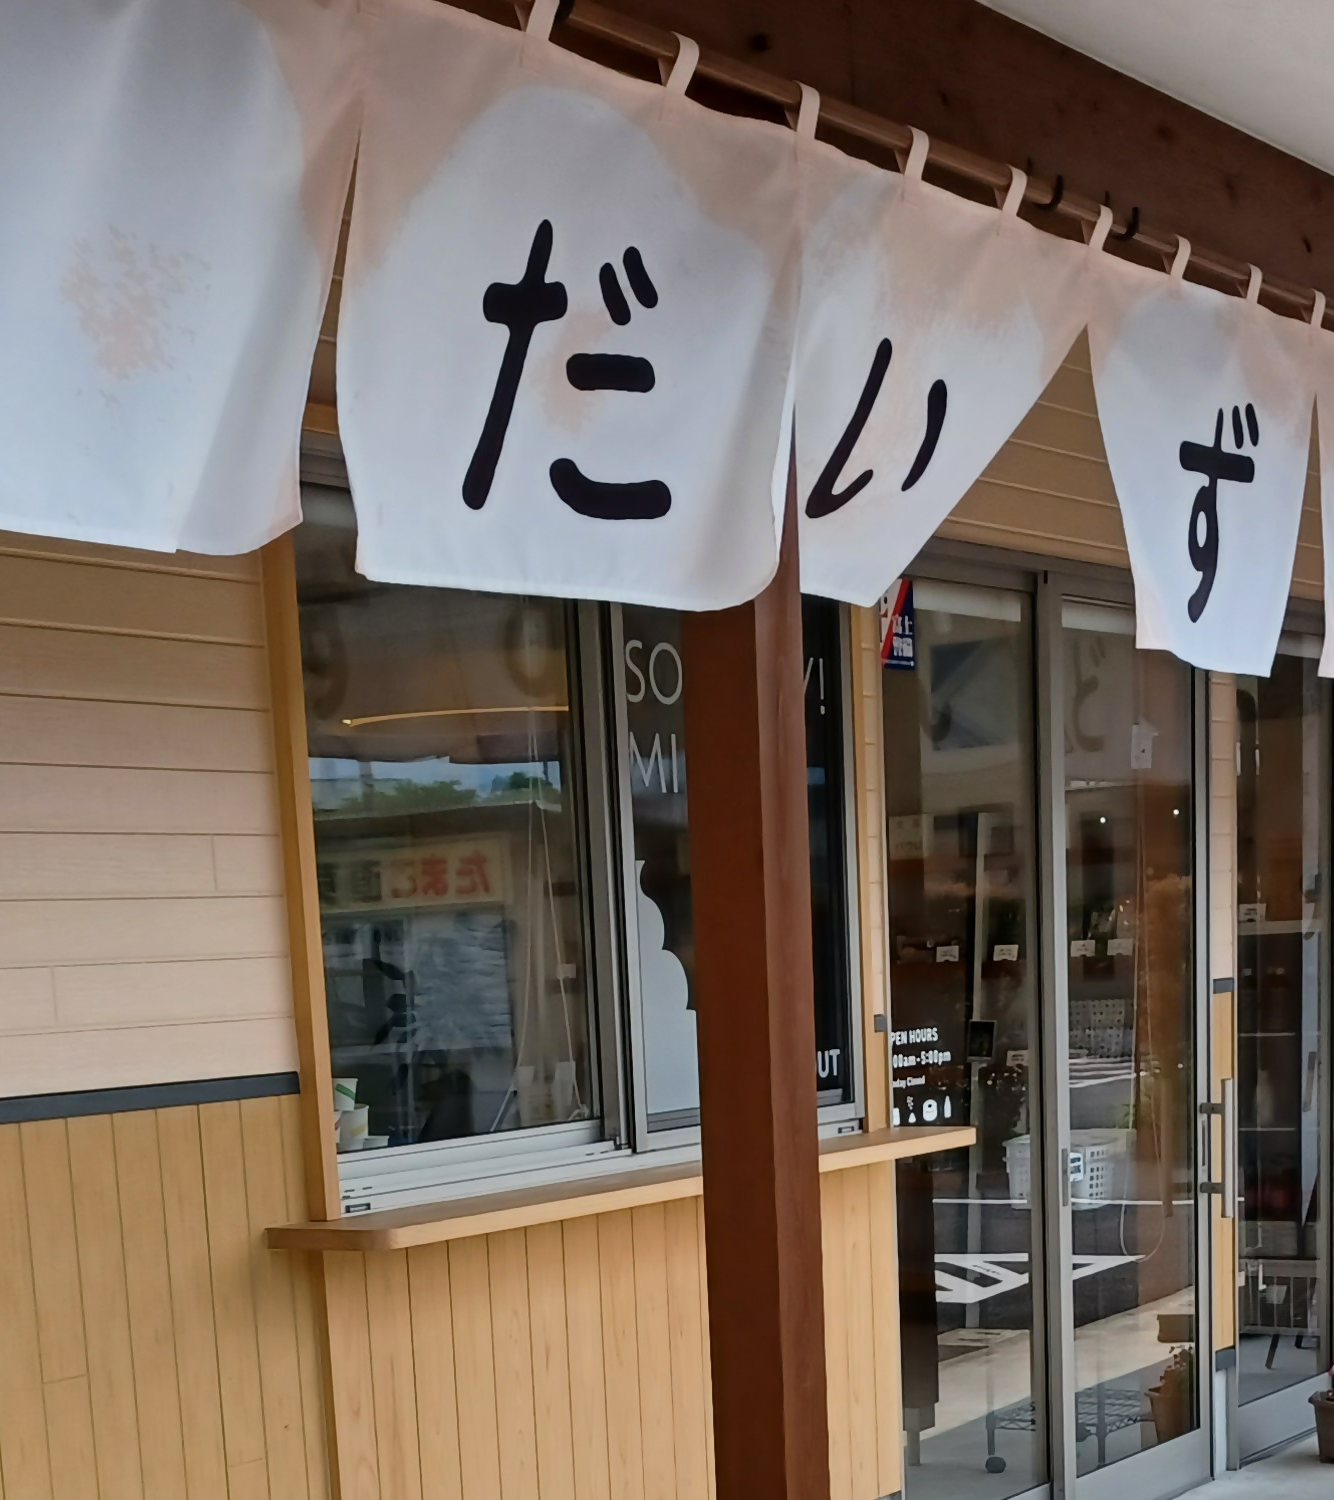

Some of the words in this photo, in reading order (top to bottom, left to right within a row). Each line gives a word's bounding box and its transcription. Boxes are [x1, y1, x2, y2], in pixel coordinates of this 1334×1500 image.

[891, 1031, 907, 1045] PEN
[909, 1028, 938, 1043] HOURS
[816, 1049, 841, 1078] UT
